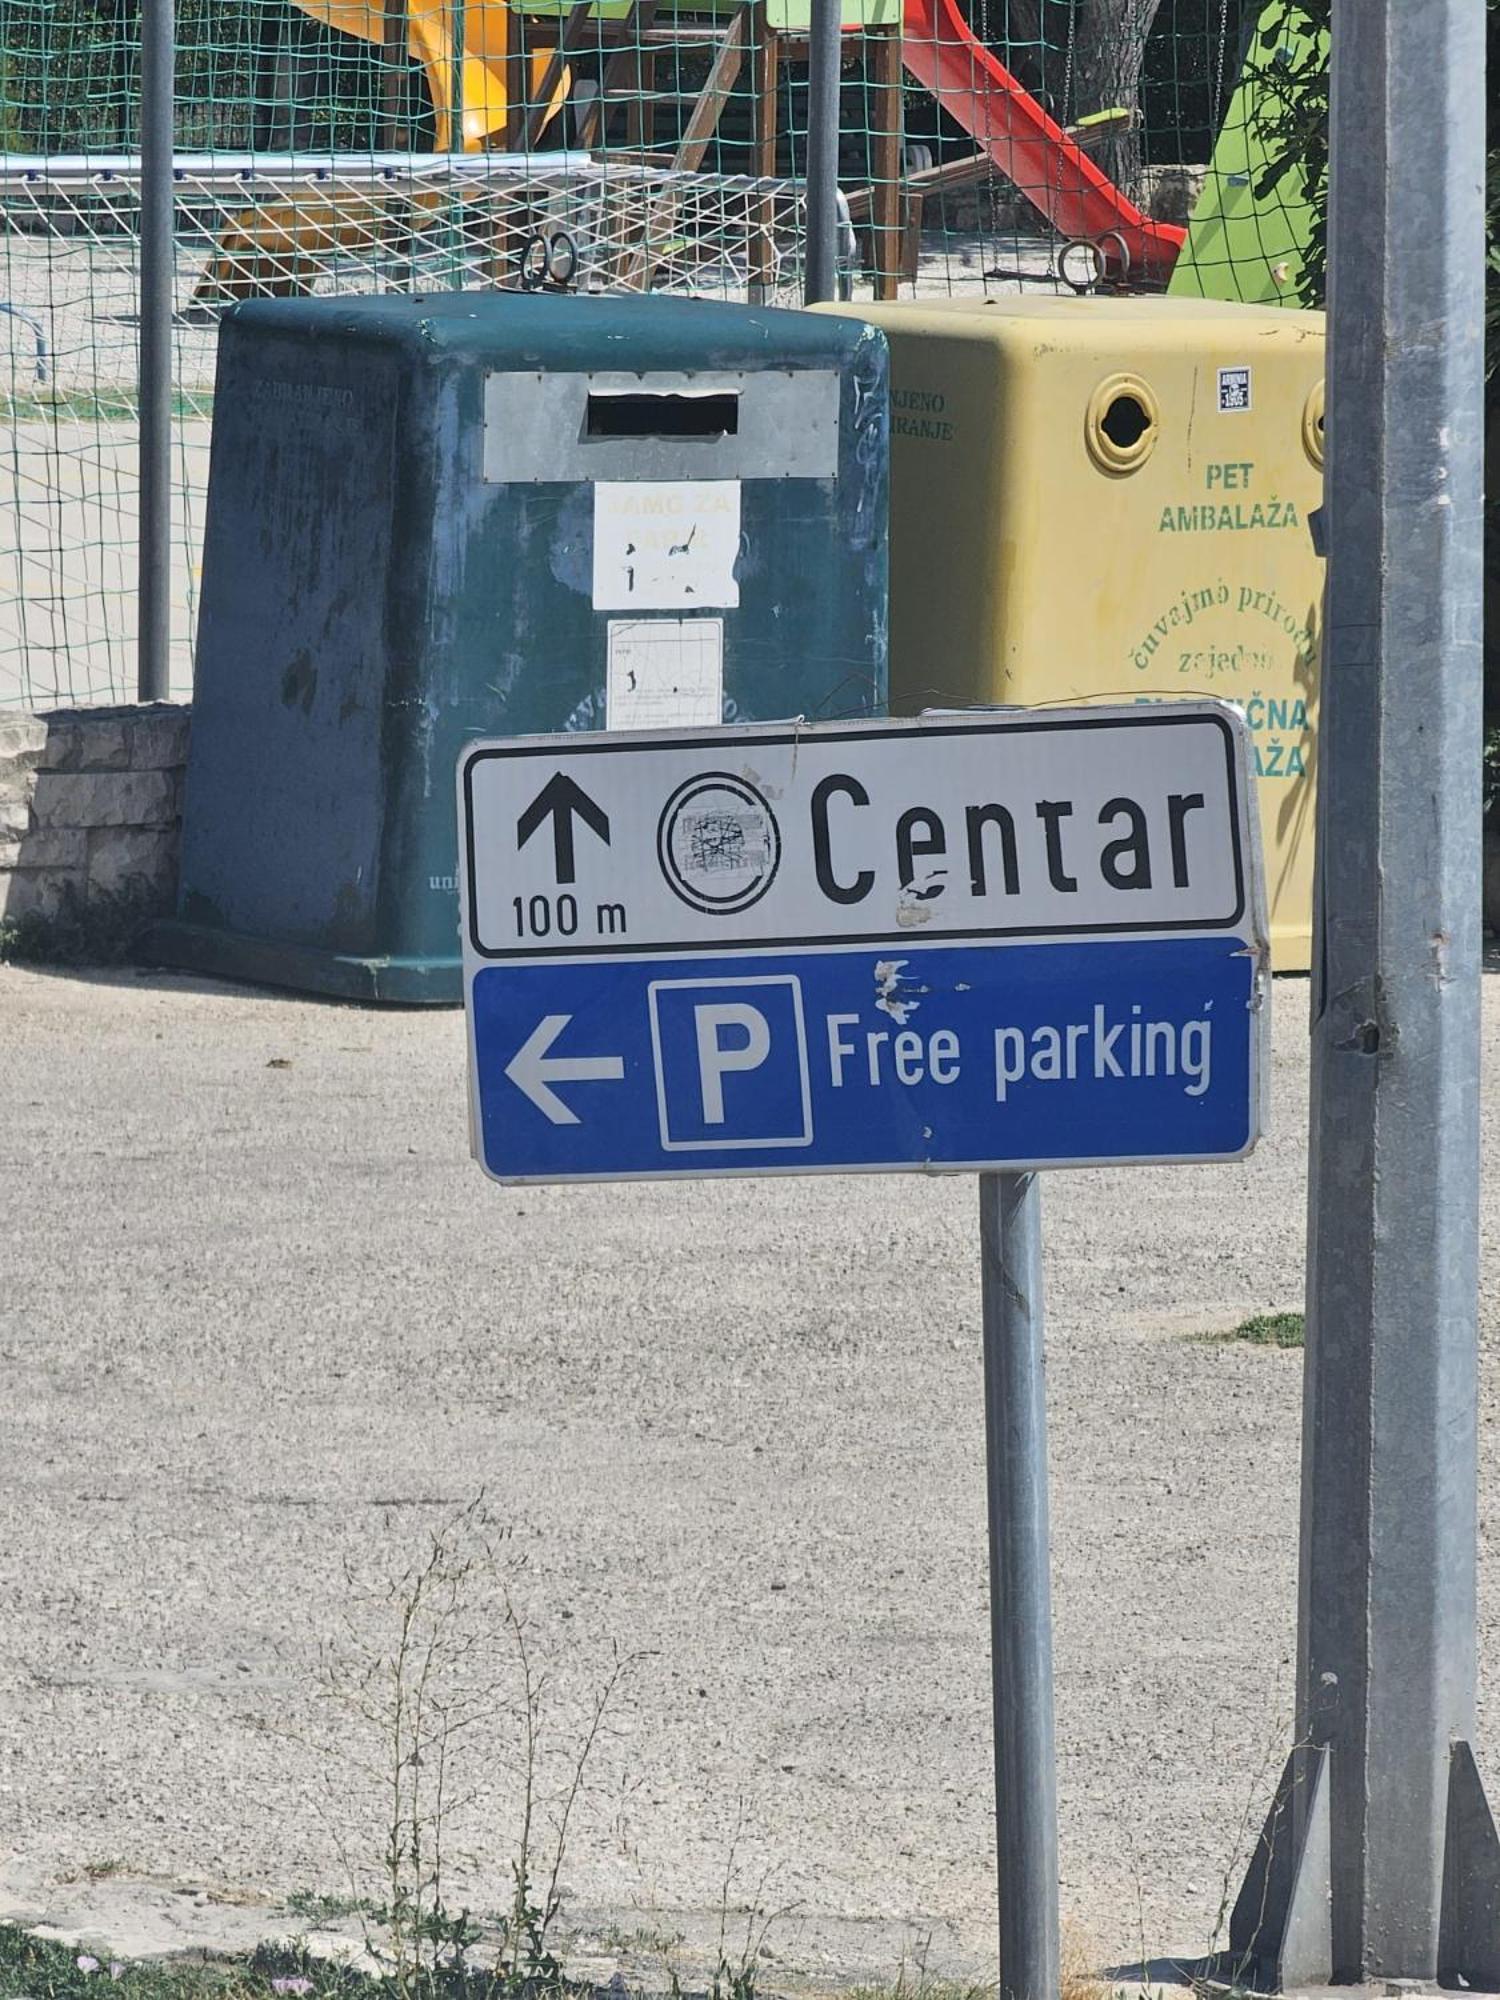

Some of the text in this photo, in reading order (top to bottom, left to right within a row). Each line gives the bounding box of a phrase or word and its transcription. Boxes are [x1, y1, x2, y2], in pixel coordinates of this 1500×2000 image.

[1206, 463, 1254, 490] PET
[1159, 494, 1299, 532] AMBALAŽA
[811, 774, 1205, 905] Centar
[513, 894, 627, 937] 100 m
[694, 1003, 771, 1125] P
[826, 1004, 1212, 1103] Free parking
